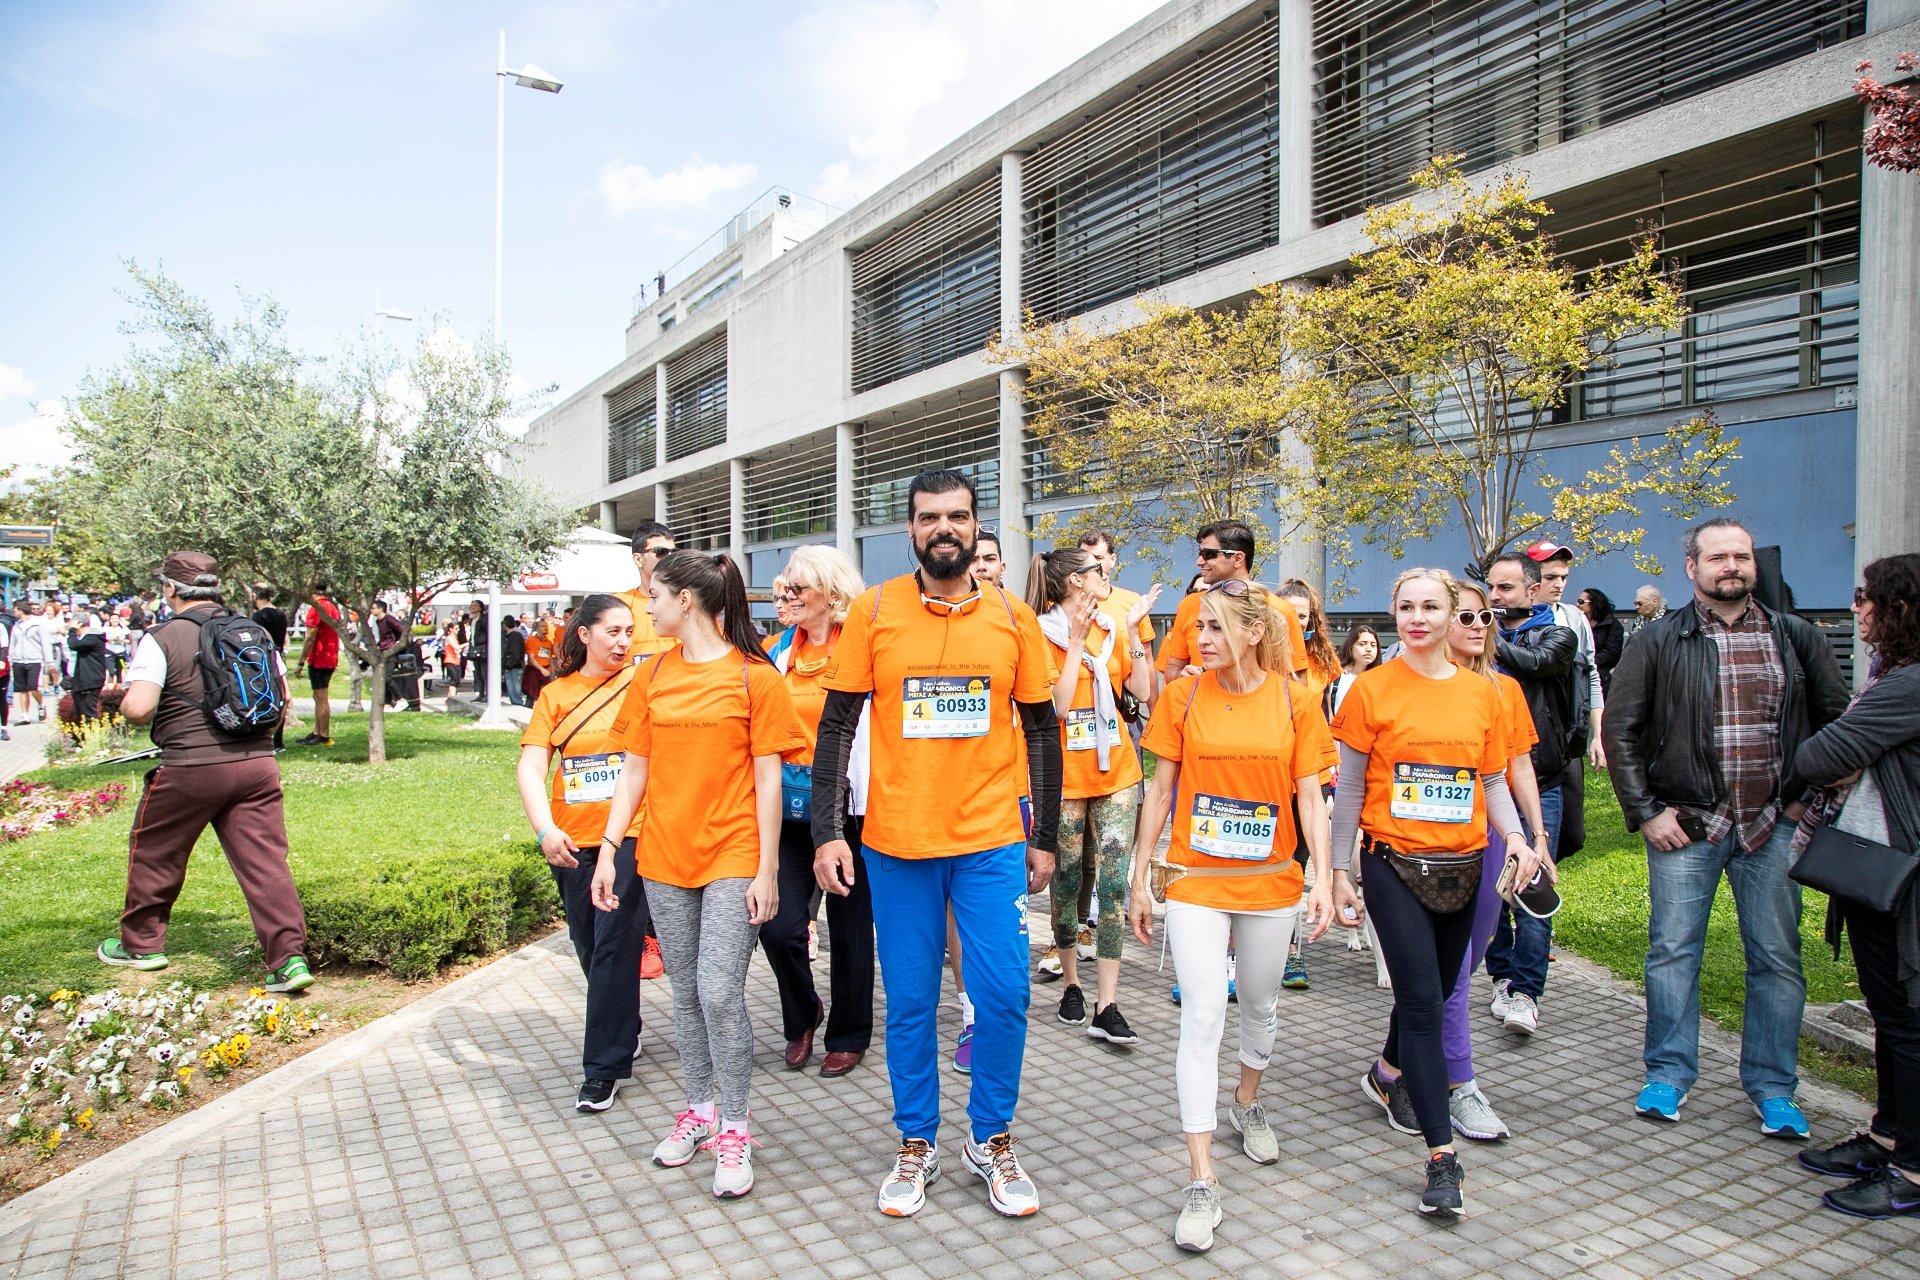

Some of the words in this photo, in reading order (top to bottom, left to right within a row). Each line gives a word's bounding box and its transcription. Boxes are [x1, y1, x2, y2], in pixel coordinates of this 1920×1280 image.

[912, 702, 924, 719] 4
[936, 698, 986, 712] 60933
[1073, 726, 1081, 737] 4
[569, 777, 577, 789] 4
[1401, 786, 1412, 801] 4
[1424, 784, 1472, 800] 61327
[1199, 820, 1209, 835] 4
[1222, 820, 1271, 837] 61085
